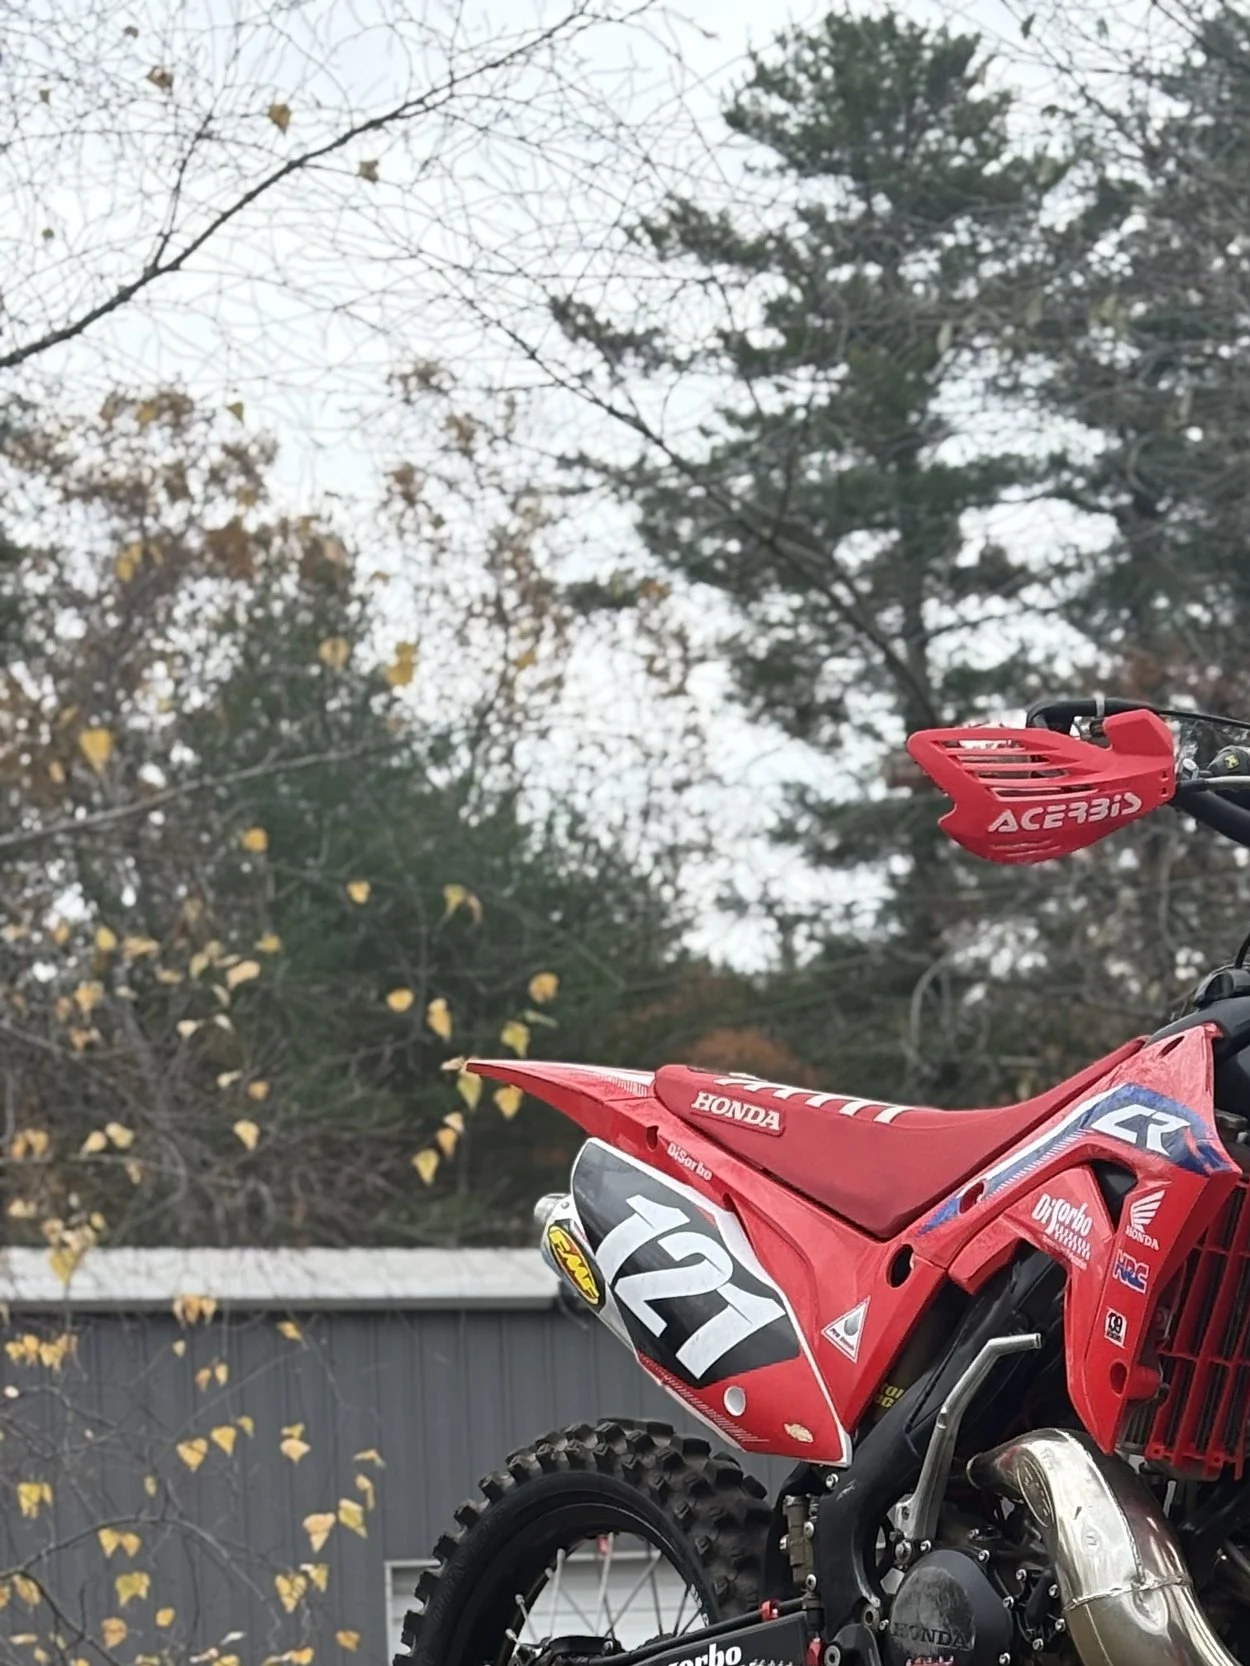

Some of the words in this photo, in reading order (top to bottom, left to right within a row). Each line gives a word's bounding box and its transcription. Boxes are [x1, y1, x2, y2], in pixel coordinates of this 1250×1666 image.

[987, 792, 1142, 832] ACERBIS
[690, 1091, 781, 1131] HONDA
[1125, 1225, 1159, 1250] HONDA
[551, 1231, 600, 1300] FMF
[1113, 1249, 1149, 1294] HRC
[596, 1195, 786, 1379] 121
[892, 1622, 970, 1649] HONDA
